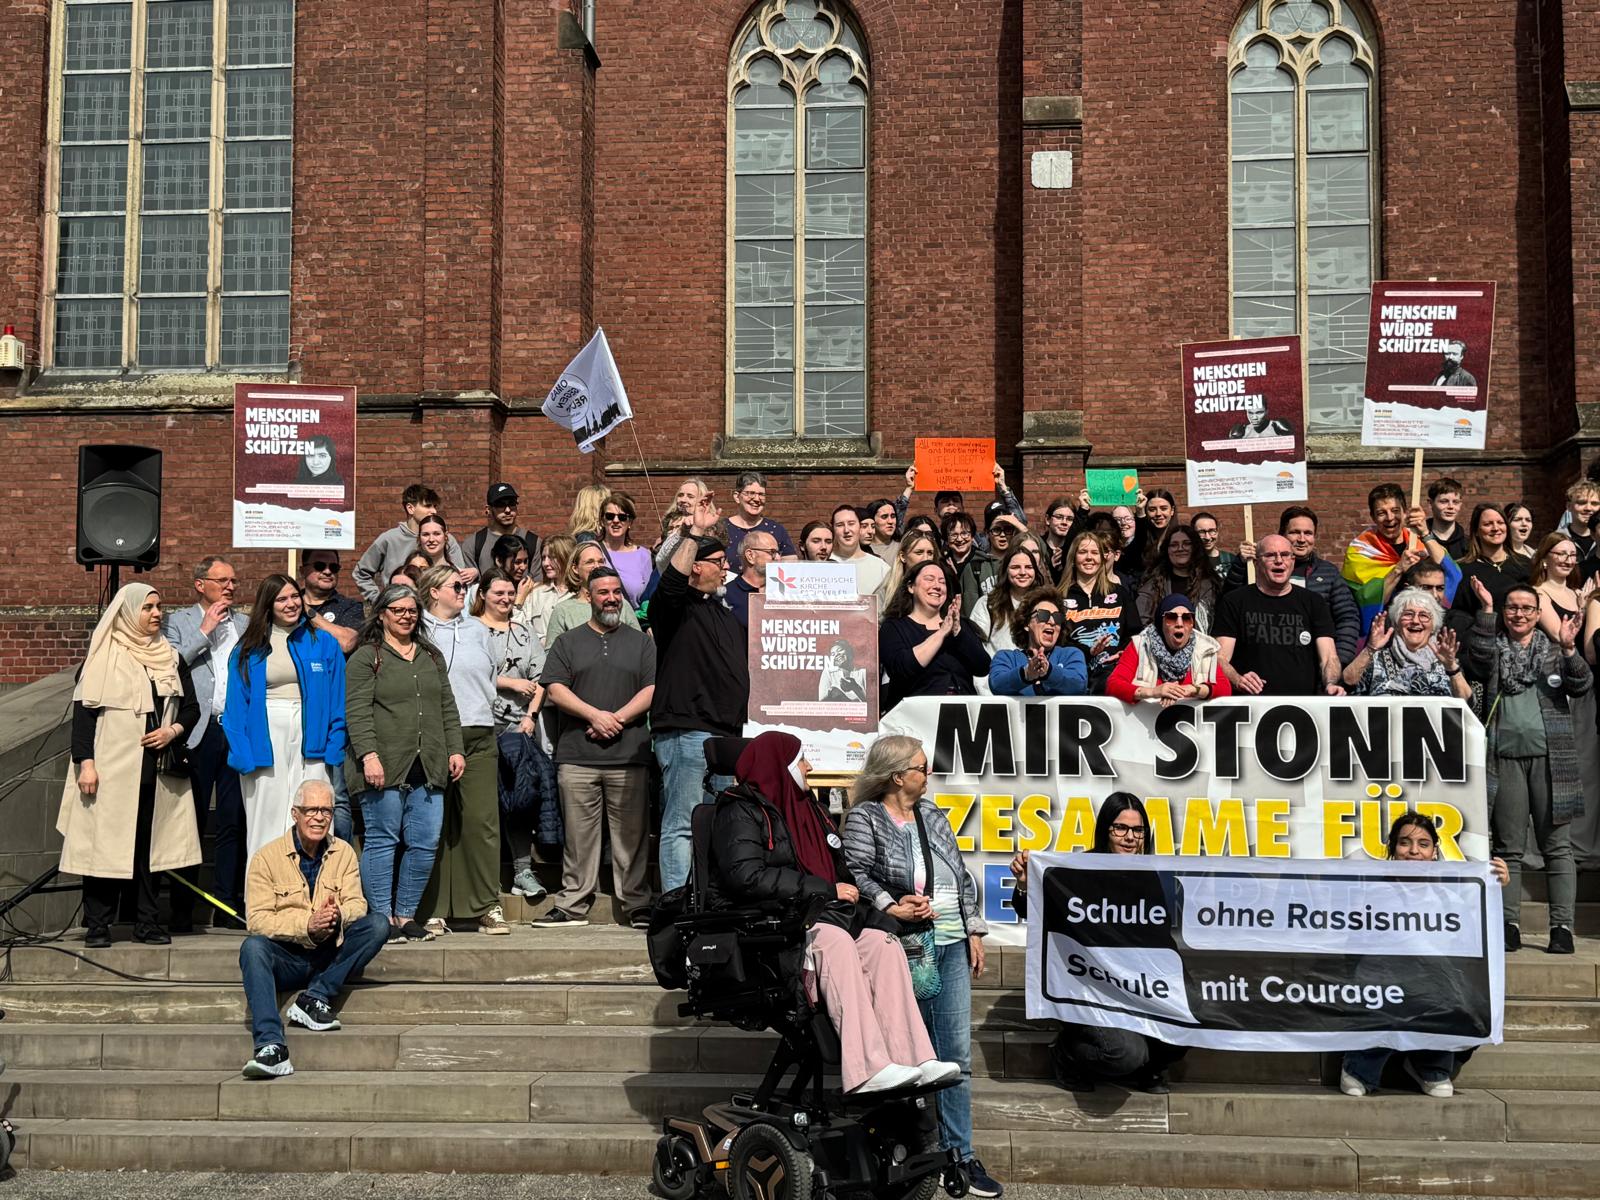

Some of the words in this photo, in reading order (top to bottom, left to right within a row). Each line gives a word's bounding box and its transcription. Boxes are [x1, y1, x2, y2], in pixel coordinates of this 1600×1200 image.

[1381, 305, 1457, 320] MENSCHEN
[1380, 320, 1433, 337] WÜRDE
[1378, 337, 1449, 353] SCHÜTZEN
[1193, 362, 1267, 380] MENSCHEN
[1193, 379, 1246, 397] WÜRDE
[1194, 394, 1263, 413] SCHÜTZEN
[245, 408, 320, 423] MENSCHEN
[245, 421, 298, 439] WÜRDE
[244, 437, 315, 455] SCHÜTZEN
[761, 619, 840, 635] MENSCHEN
[1245, 611, 1275, 625] MUT
[1278, 613, 1304, 627] ZUR
[761, 634, 817, 653] WÜRDE
[761, 652, 836, 670] SCHÜTZEN
[931, 703, 1117, 777] MIR
[1154, 704, 1466, 782] STONN
[1067, 896, 1167, 925] Schule
[1197, 901, 1275, 927] ohne
[1287, 903, 1461, 932] Rassismus
[1067, 952, 1170, 1000] Schule
[1201, 975, 1249, 1002] mit
[1261, 975, 1405, 1010] Courage
